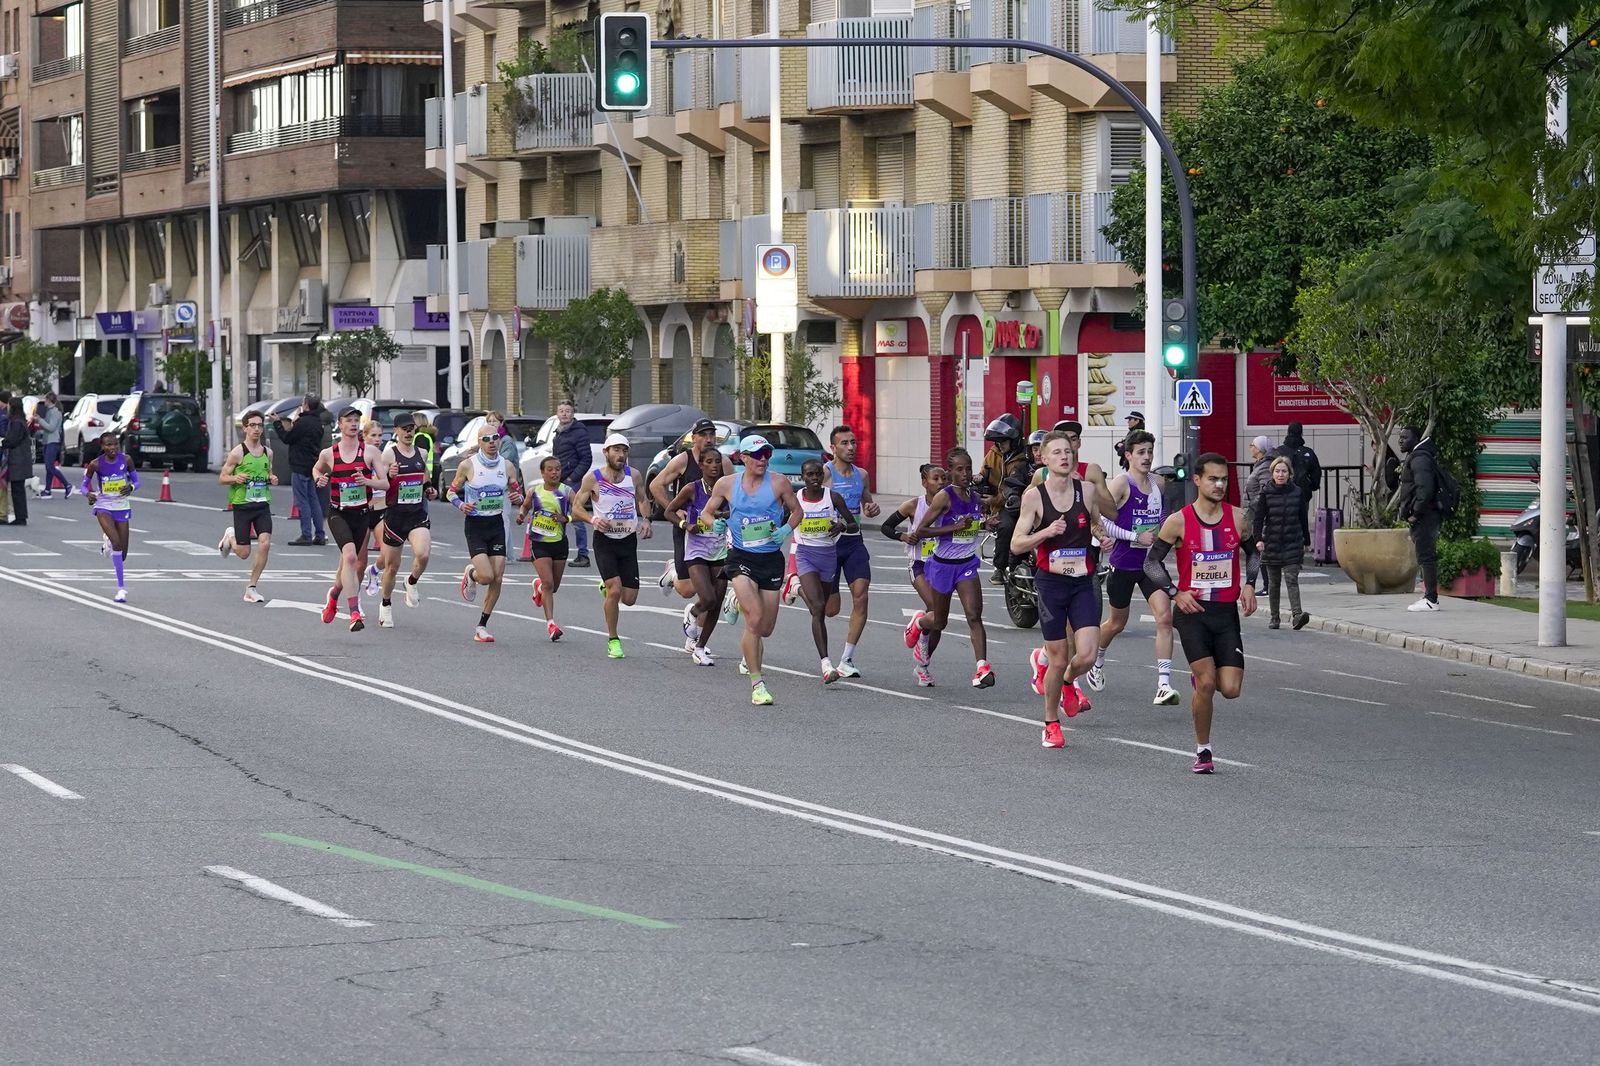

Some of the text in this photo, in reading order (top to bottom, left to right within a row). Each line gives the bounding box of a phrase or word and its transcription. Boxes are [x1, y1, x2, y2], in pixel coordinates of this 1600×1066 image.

[338, 317, 375, 325] PIERCING
[1277, 384, 1297, 392] BEBIDAS
[1277, 398, 1309, 407] CHARCUTERÍA
[1308, 398, 1329, 406] ASISTIDA
[751, 515, 770, 523] ZURICH
[1206, 553, 1228, 561] ZURICH
[1195, 571, 1229, 580] PEZUELA
